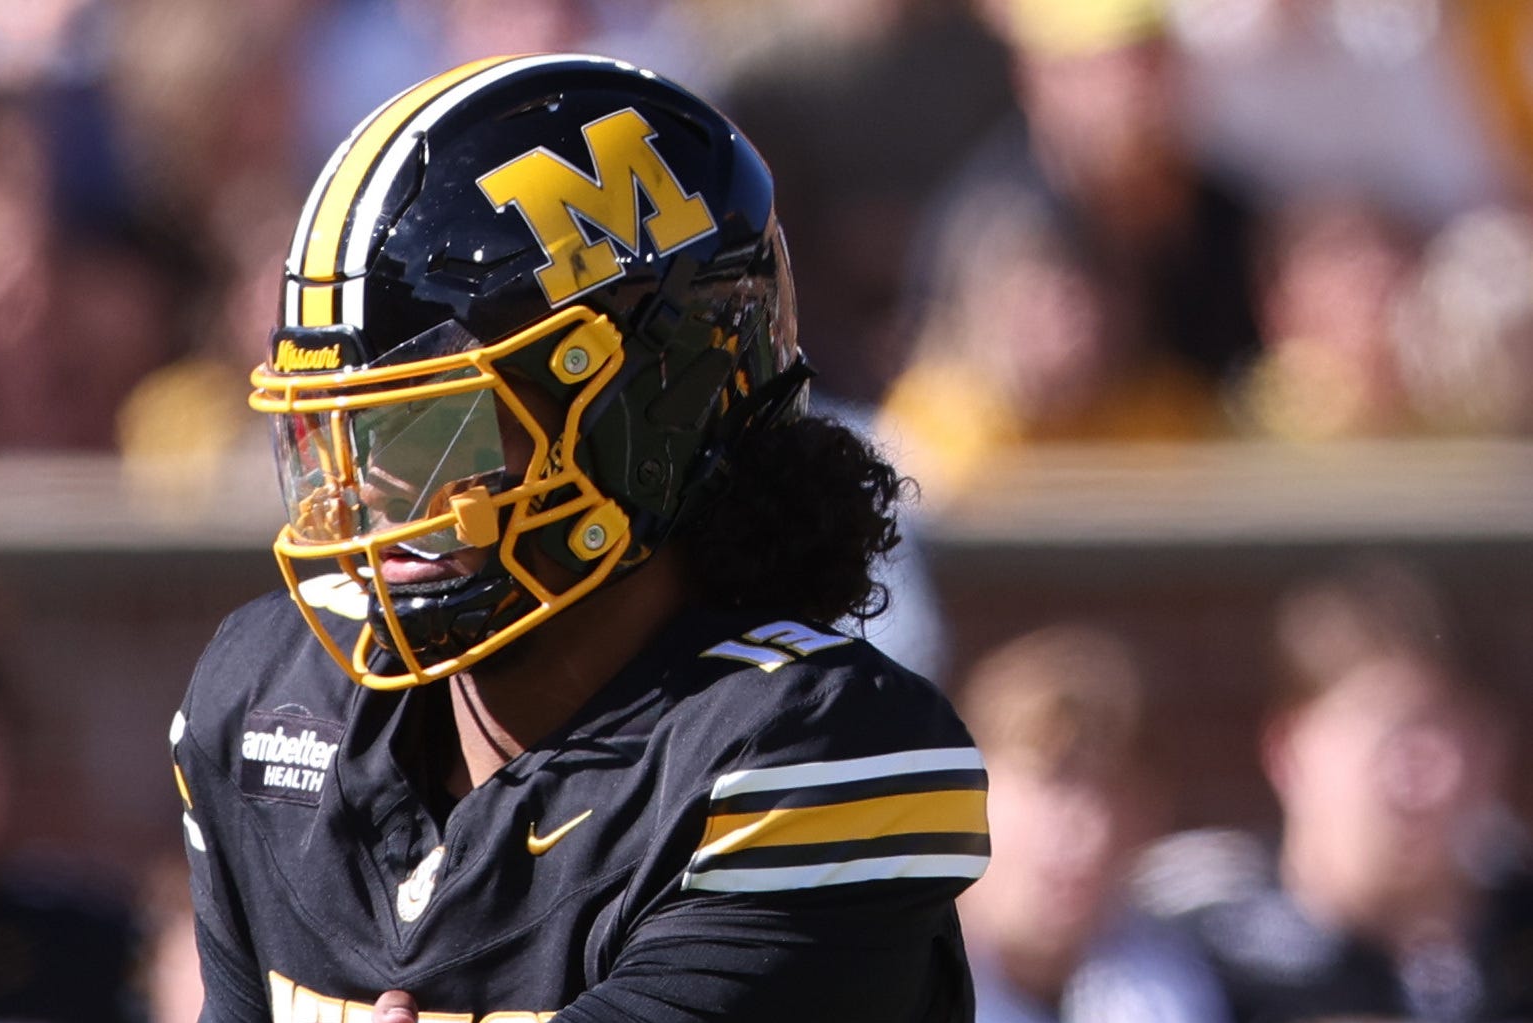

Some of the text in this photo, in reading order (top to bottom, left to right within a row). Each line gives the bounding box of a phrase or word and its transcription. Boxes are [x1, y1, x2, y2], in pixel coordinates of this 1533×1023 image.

[476, 107, 718, 308] M
[274, 339, 341, 373] Missouri
[242, 726, 338, 770] ambetter
[264, 765, 325, 792] HEALTH
